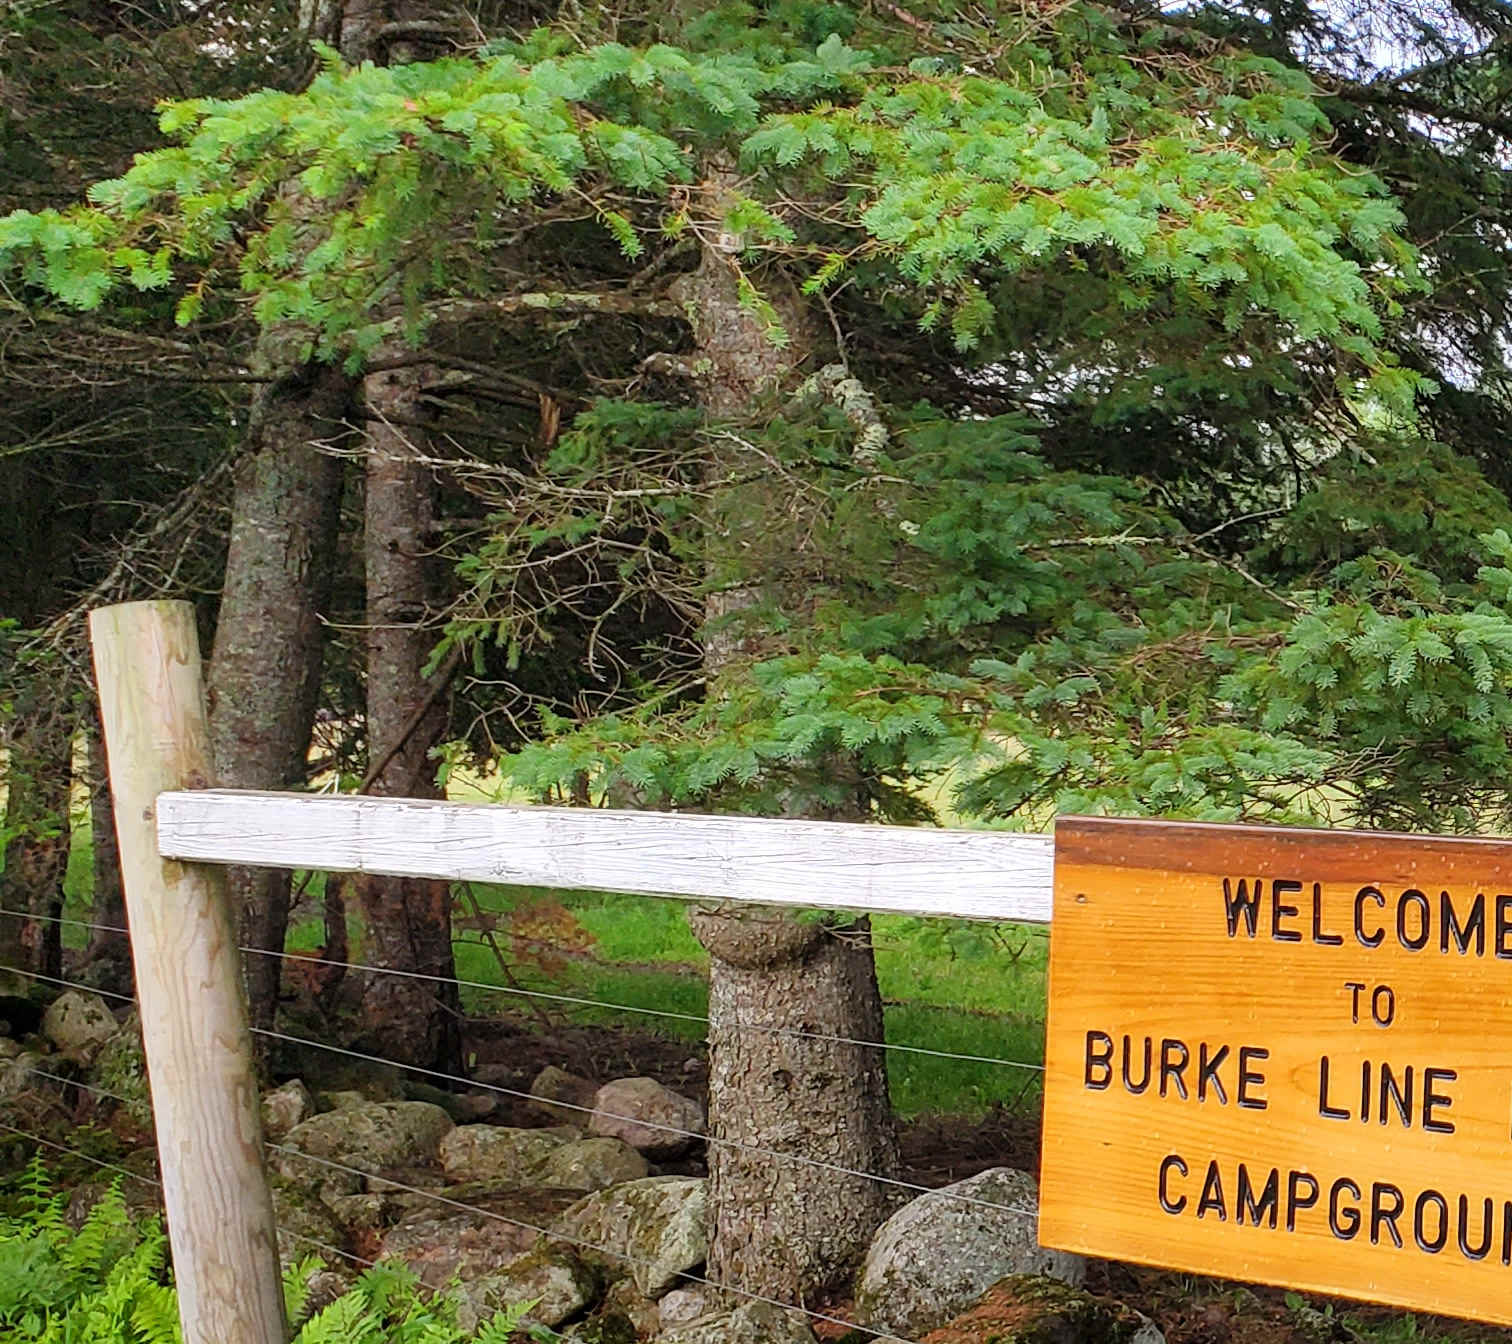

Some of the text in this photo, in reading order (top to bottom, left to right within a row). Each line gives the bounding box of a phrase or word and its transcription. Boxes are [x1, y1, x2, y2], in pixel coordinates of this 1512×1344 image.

[1345, 982, 1395, 1027] TO
[1084, 1030, 1270, 1110] BURKE
[1318, 1055, 1457, 1133] LINE
